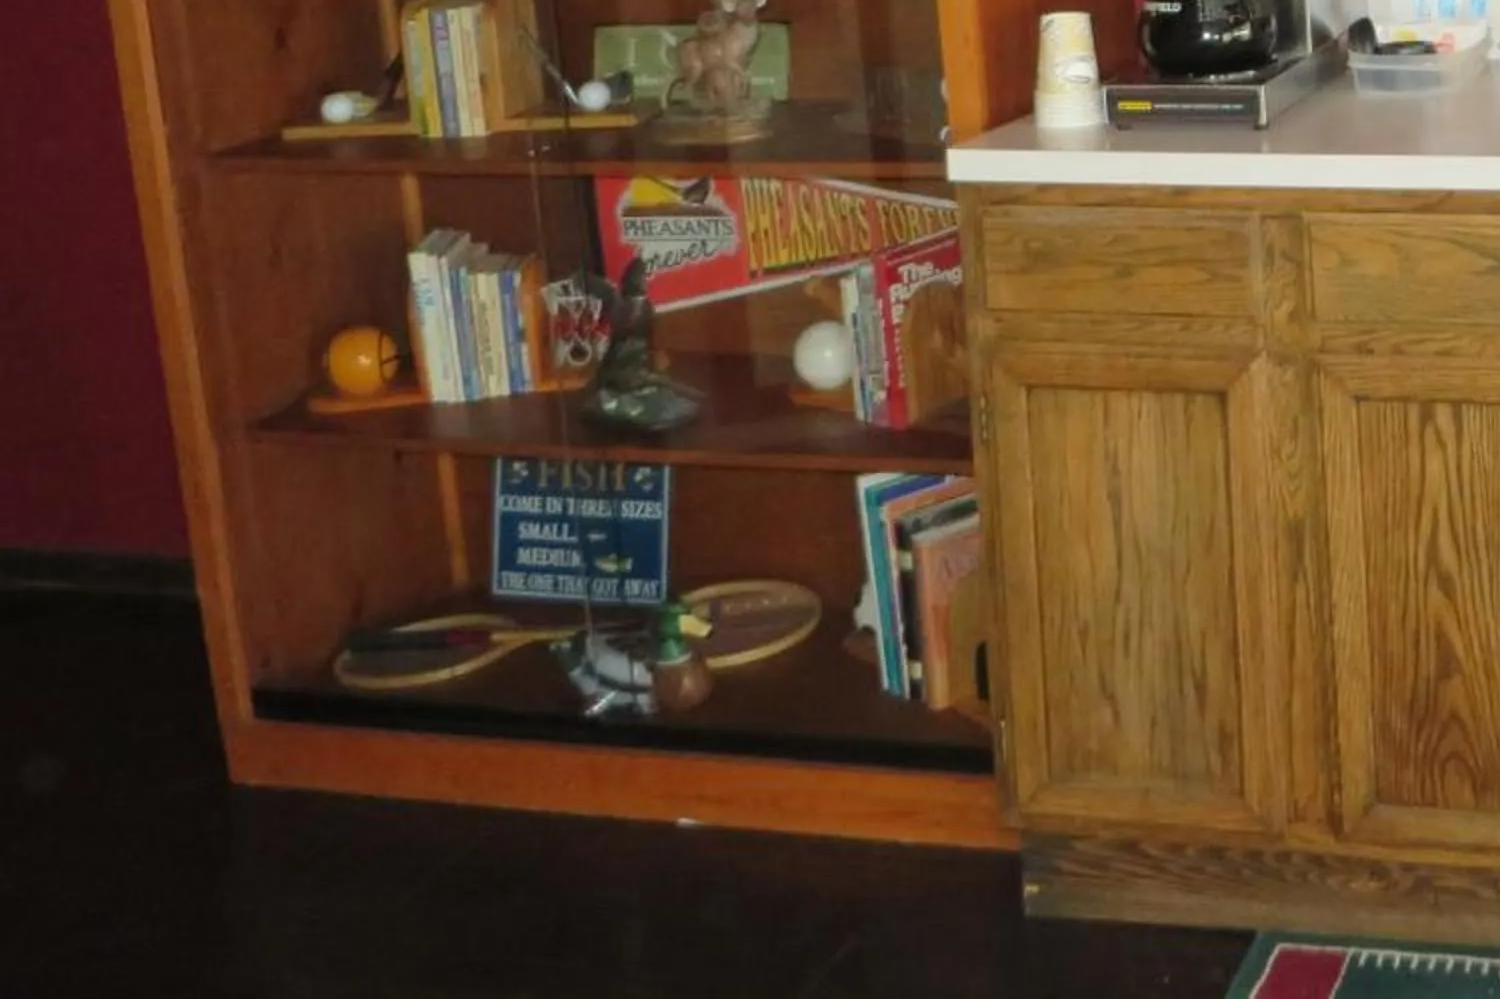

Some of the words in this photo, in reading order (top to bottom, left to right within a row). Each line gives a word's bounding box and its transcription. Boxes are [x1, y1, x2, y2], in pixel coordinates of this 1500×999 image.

[623, 218, 735, 238] PHEASANTS
[741, 178, 872, 272] PHEASANTS
[501, 494, 542, 513] COME
[620, 499, 662, 519] SIZES
[518, 521, 579, 542] SMALL
[623, 578, 661, 598] AWAY
